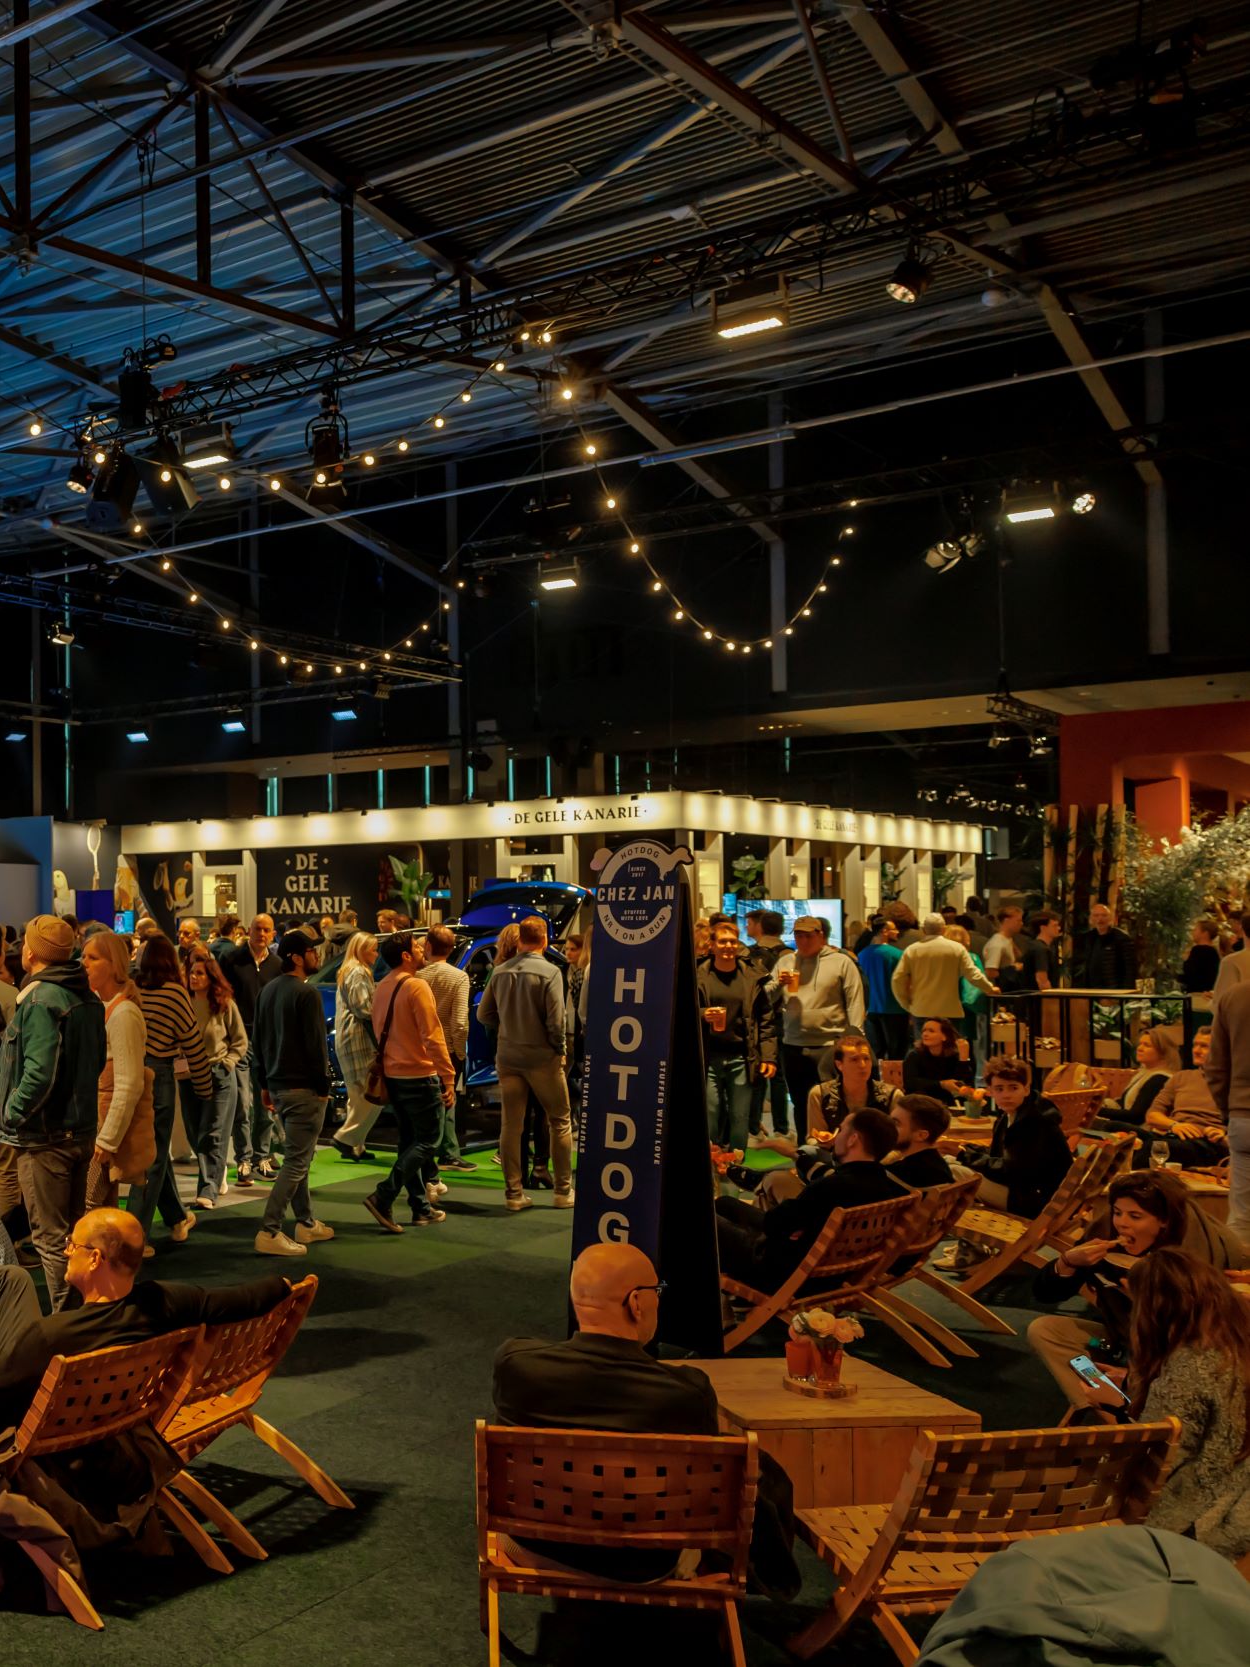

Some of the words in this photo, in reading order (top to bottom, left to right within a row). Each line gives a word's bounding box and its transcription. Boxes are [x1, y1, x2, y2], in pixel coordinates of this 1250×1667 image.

[514, 812, 530, 824] DE
[535, 810, 565, 823] GELE
[574, 806, 641, 821] KANARIE
[296, 853, 318, 870] DE
[620, 846, 660, 860] HOTDOG
[285, 874, 329, 892] GELE
[598, 886, 636, 901] CHEZ
[642, 886, 674, 900] JAN
[604, 914, 613, 928] NR
[622, 932, 634, 940] ON
[648, 914, 666, 934] BUN
[658, 1060, 666, 1104] STUFFED
[580, 1112, 588, 1153] STUFFED
[654, 1140, 662, 1165] LOVE
